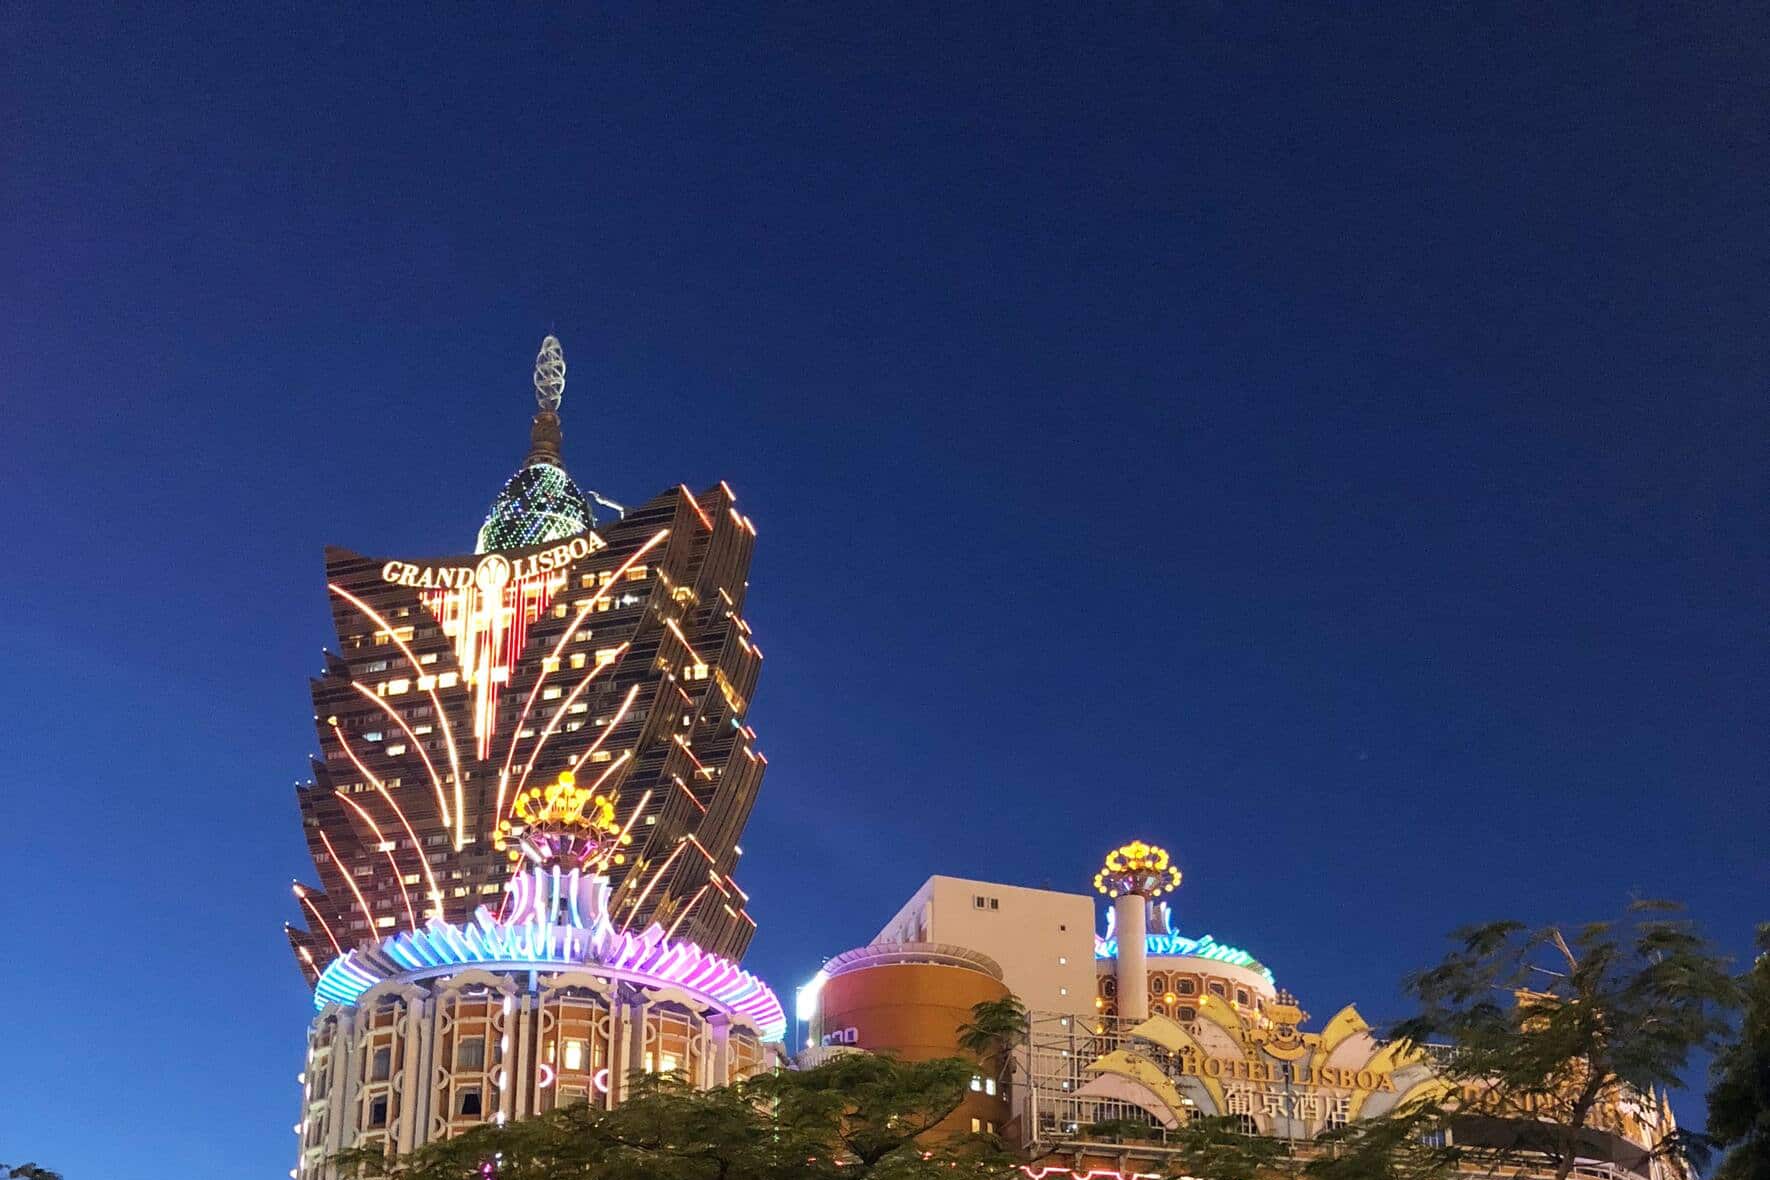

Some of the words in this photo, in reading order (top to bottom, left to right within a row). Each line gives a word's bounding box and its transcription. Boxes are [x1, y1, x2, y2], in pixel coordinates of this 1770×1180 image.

[382, 560, 476, 589] GRAND
[512, 530, 607, 581] LISBOA
[1181, 1054, 1285, 1083] HOTEL
[1291, 1061, 1398, 1093] LISBOA
[1223, 1082, 1352, 1124] 葡京酒店
